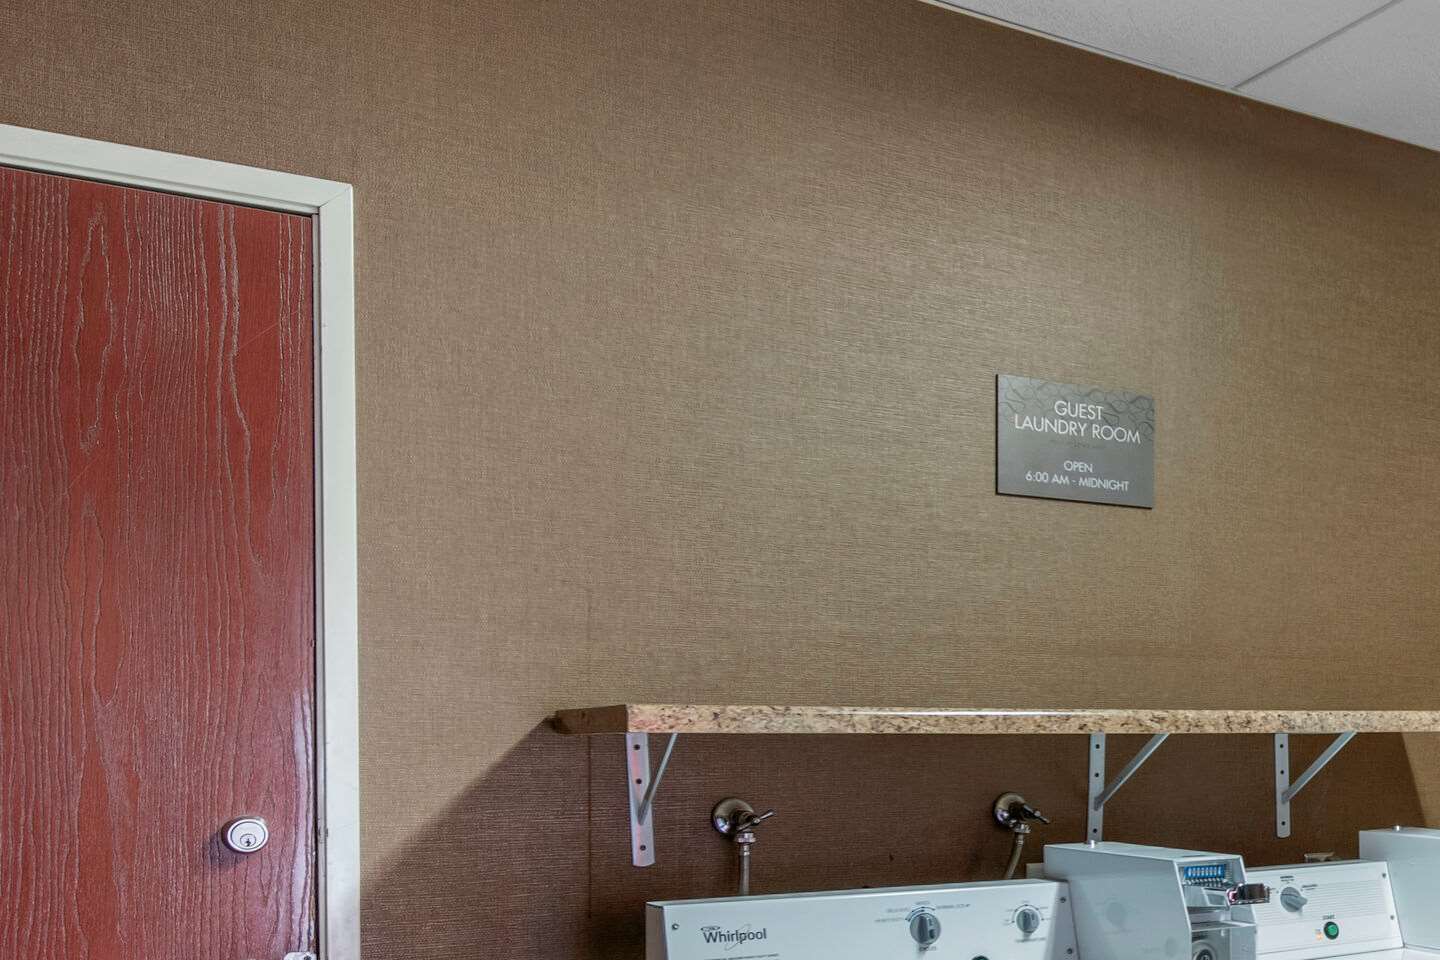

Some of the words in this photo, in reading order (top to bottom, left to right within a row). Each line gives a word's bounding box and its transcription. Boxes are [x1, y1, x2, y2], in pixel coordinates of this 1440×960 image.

[1054, 400, 1104, 420] GUEST
[1014, 414, 1088, 437] LAUNDRY
[1092, 423, 1142, 444] ROOM
[1063, 460, 1093, 473] OPEN
[1025, 471, 1049, 483] 6:00
[1051, 473, 1069, 485] AM
[1078, 477, 1130, 492] MIDNIGHT
[703, 927, 767, 944] Whirlpool
